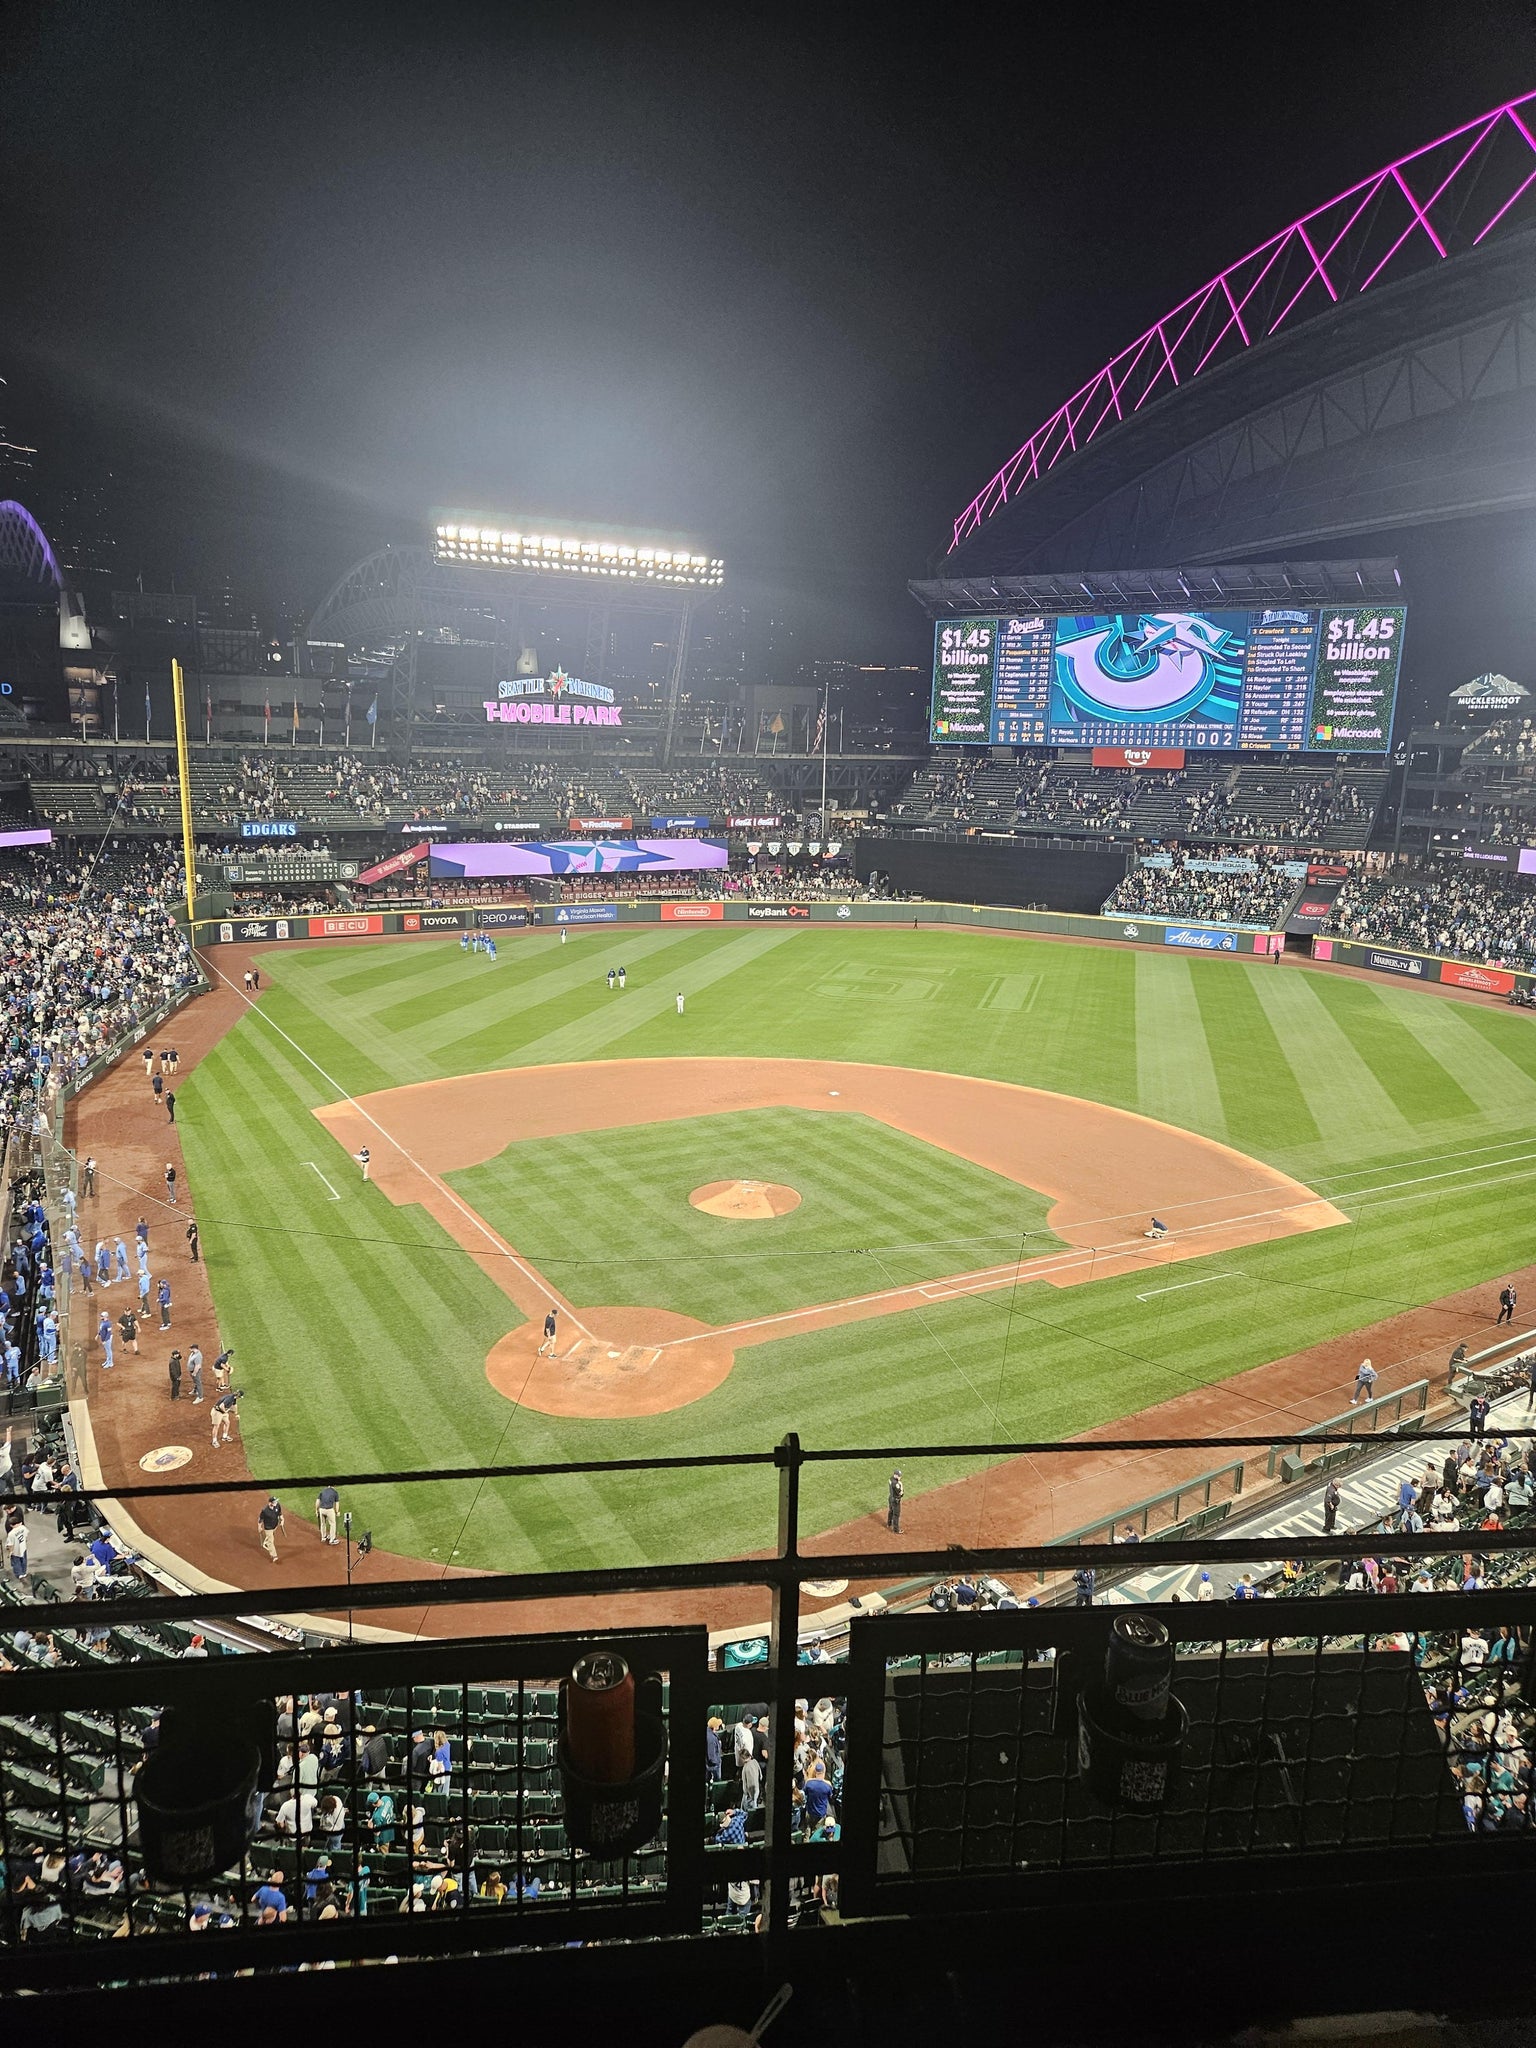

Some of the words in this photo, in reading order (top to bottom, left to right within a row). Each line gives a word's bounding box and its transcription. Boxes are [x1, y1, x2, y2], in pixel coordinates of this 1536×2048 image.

[1008, 617, 1044, 634] Royals
[1328, 617, 1394, 642] $1.45
[942, 628, 990, 649] $1.45
[942, 650, 988, 665] billion
[1327, 643, 1390, 660] billion
[498, 678, 544, 698] SEATTLE
[567, 678, 614, 703] MARINERS
[1458, 696, 1521, 705] MUCKLESHOOT
[483, 701, 571, 724] T-MOBILE
[573, 705, 622, 725] PARK
[950, 722, 985, 732] Microsoft
[1334, 727, 1382, 738] Microsoft
[1197, 732, 1206, 745] 0
[1210, 732, 1219, 745] 0
[1224, 732, 1232, 745] 2
[1124, 749, 1140, 759] fire
[1141, 750, 1152, 760] tv
[243, 823, 296, 837] EDGARS
[453, 896, 502, 905] NORTHWEST
[478, 913, 507, 923] eero
[749, 907, 788, 917] KeyBank
[328, 921, 365, 931] BECU
[422, 916, 458, 926] TOYOTA
[1168, 931, 1212, 946] Alaska
[1117, 1685, 1150, 1704] BLUE
